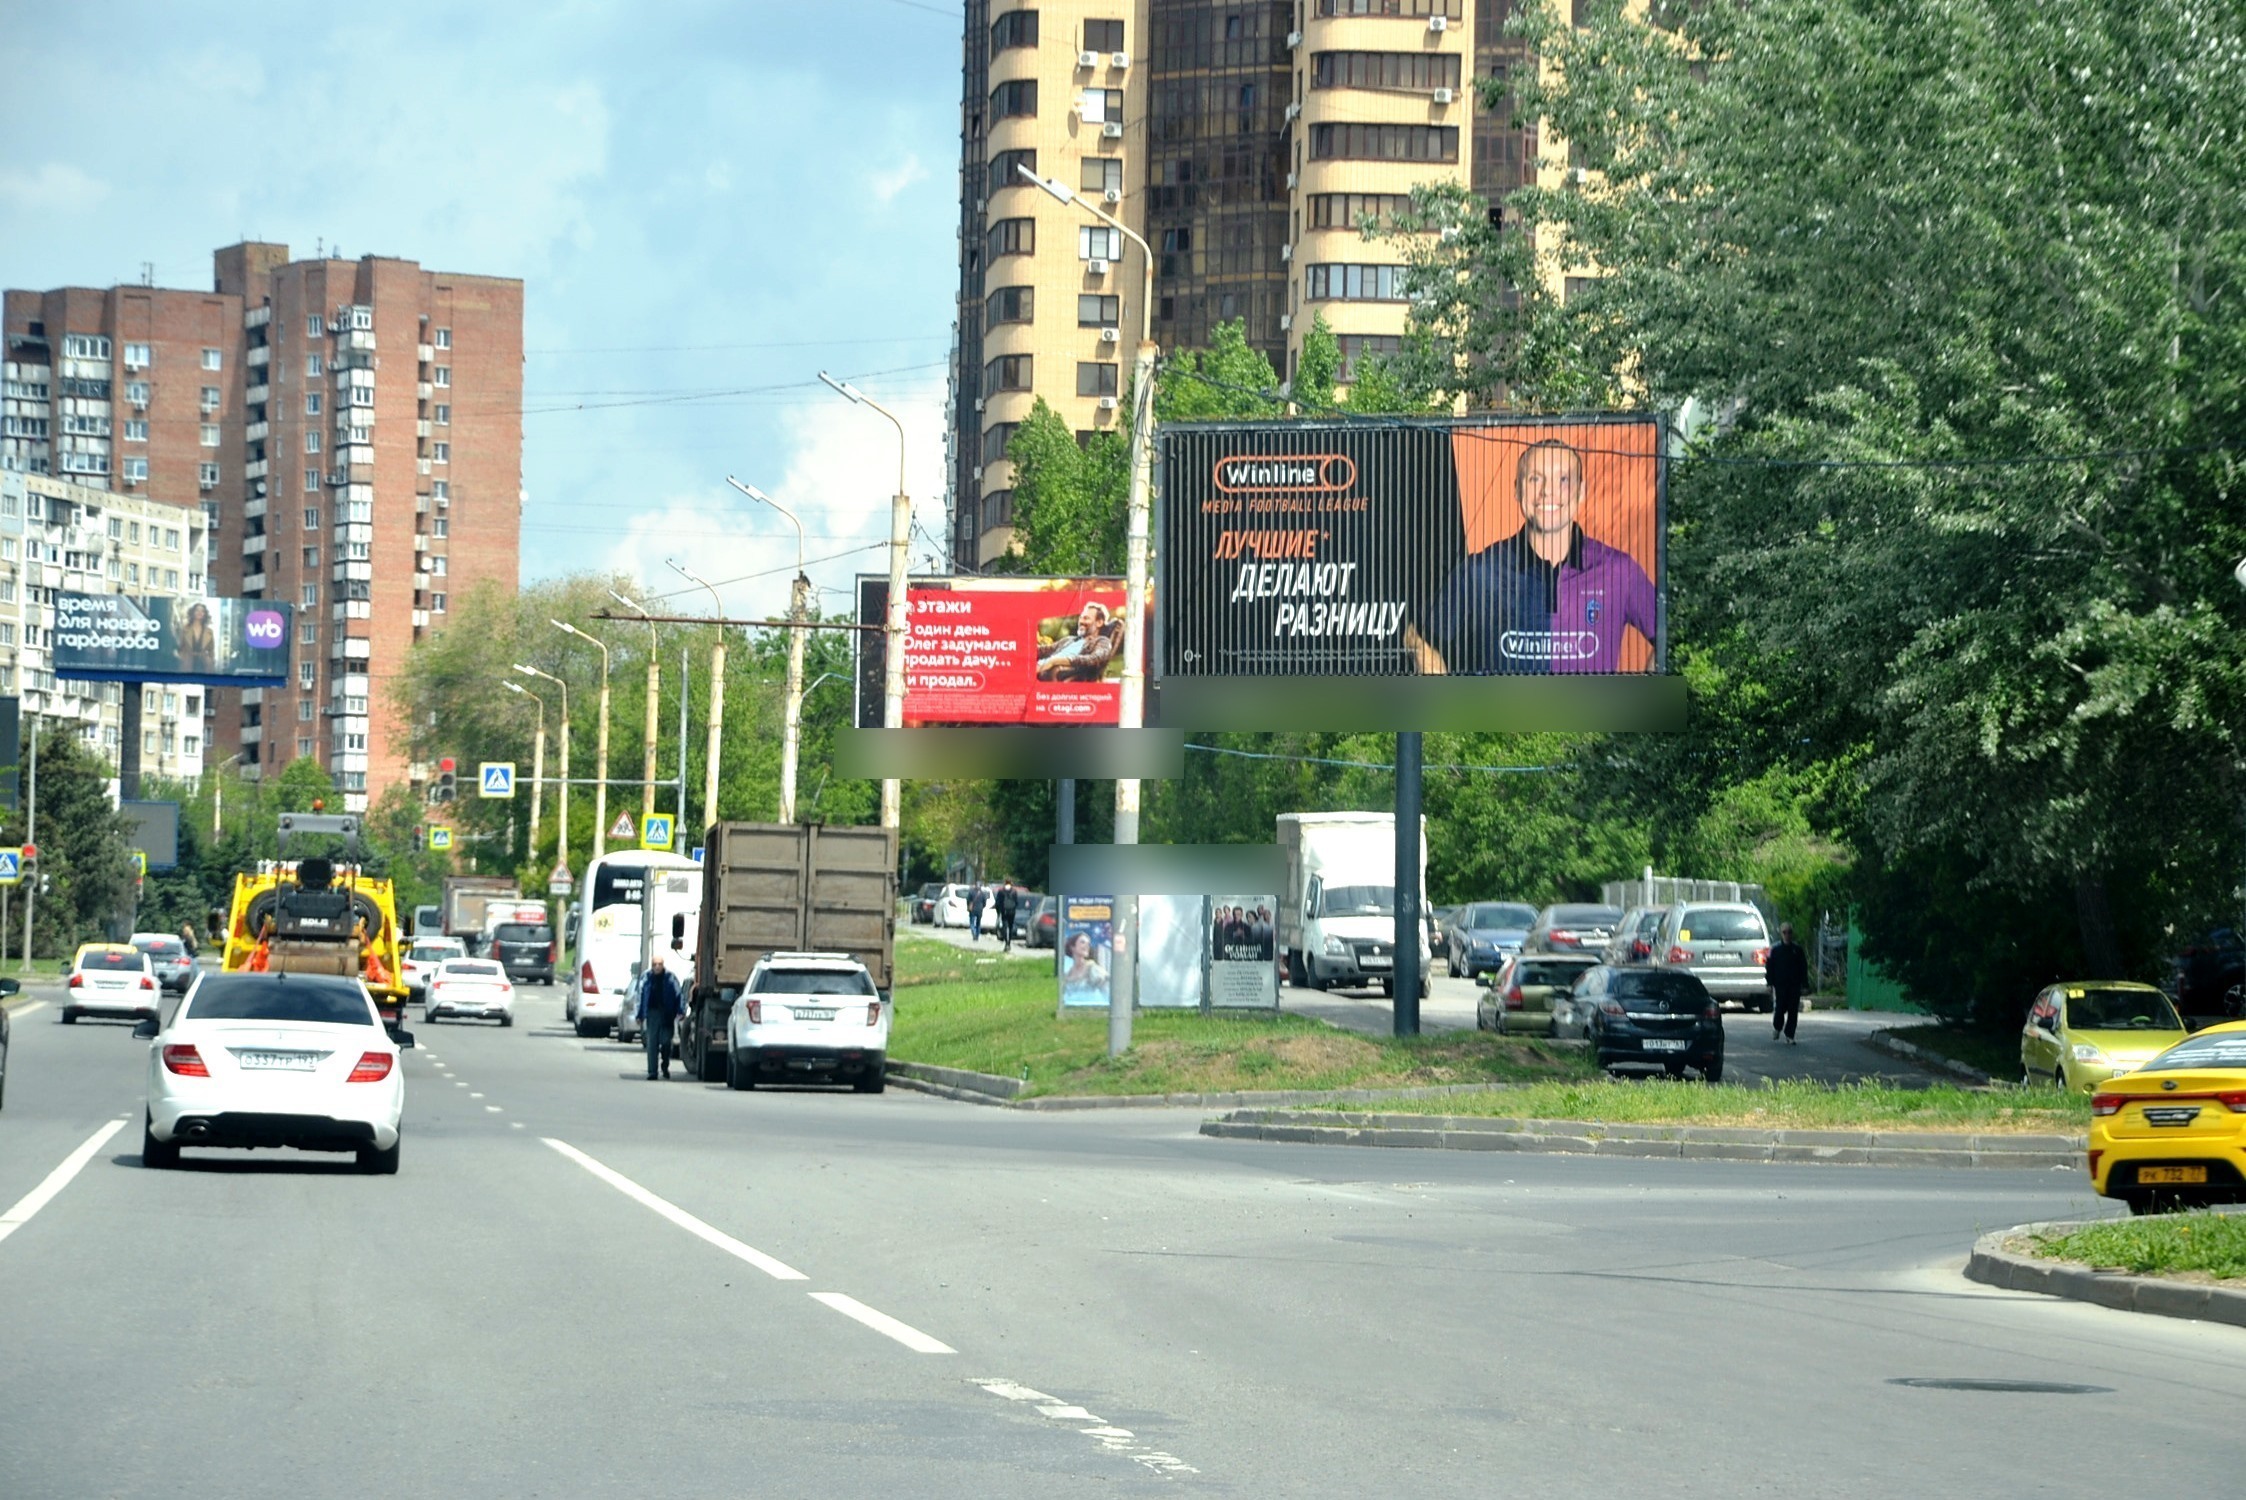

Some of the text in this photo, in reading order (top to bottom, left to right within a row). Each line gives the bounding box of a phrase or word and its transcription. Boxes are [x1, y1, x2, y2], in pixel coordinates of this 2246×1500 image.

[1227, 464, 1315, 484] Winline
[1201, 497, 1369, 514] MEDIA FOOTBALL LEAGUE
[1231, 563, 1356, 603] ДЕЛАЮТ
[58, 598, 118, 614] время
[917, 600, 971, 614] этажи
[58, 615, 161, 632] для нового
[248, 618, 281, 637] wb
[1274, 602, 1406, 640] РАЗНИЦУ
[915, 624, 952, 637] один
[954, 625, 990, 637] день
[57, 633, 159, 650] гардероба
[904, 638, 1017, 654] Олег задумался
[1508, 637, 1573, 653] Winline
[907, 675, 977, 689] и продал.
